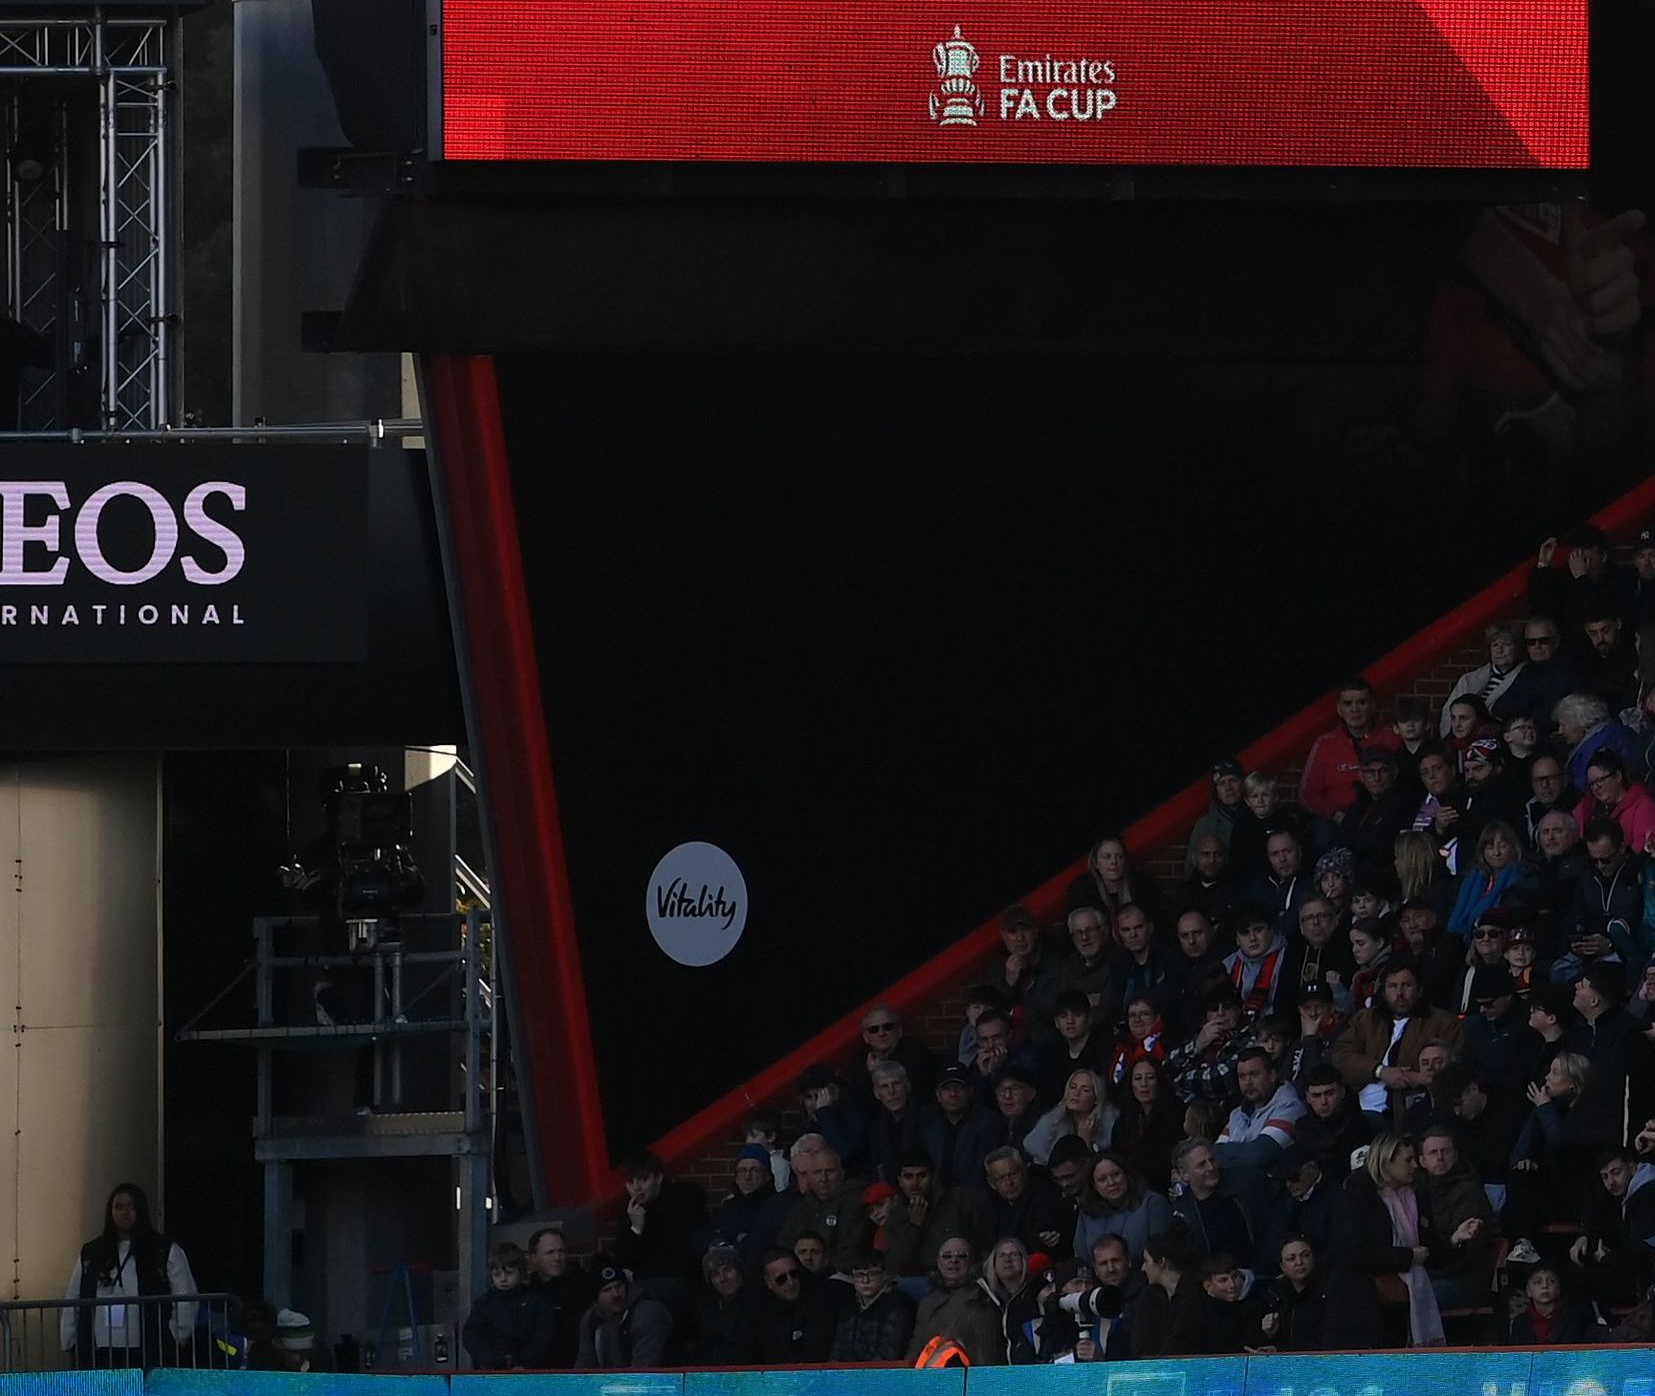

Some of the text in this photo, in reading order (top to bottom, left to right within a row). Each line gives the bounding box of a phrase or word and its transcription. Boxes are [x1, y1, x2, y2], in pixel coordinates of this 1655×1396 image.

[1000, 53, 1116, 85] Emirates
[1000, 89, 1116, 121] FA CUP
[657, 877, 736, 930] Vitality
